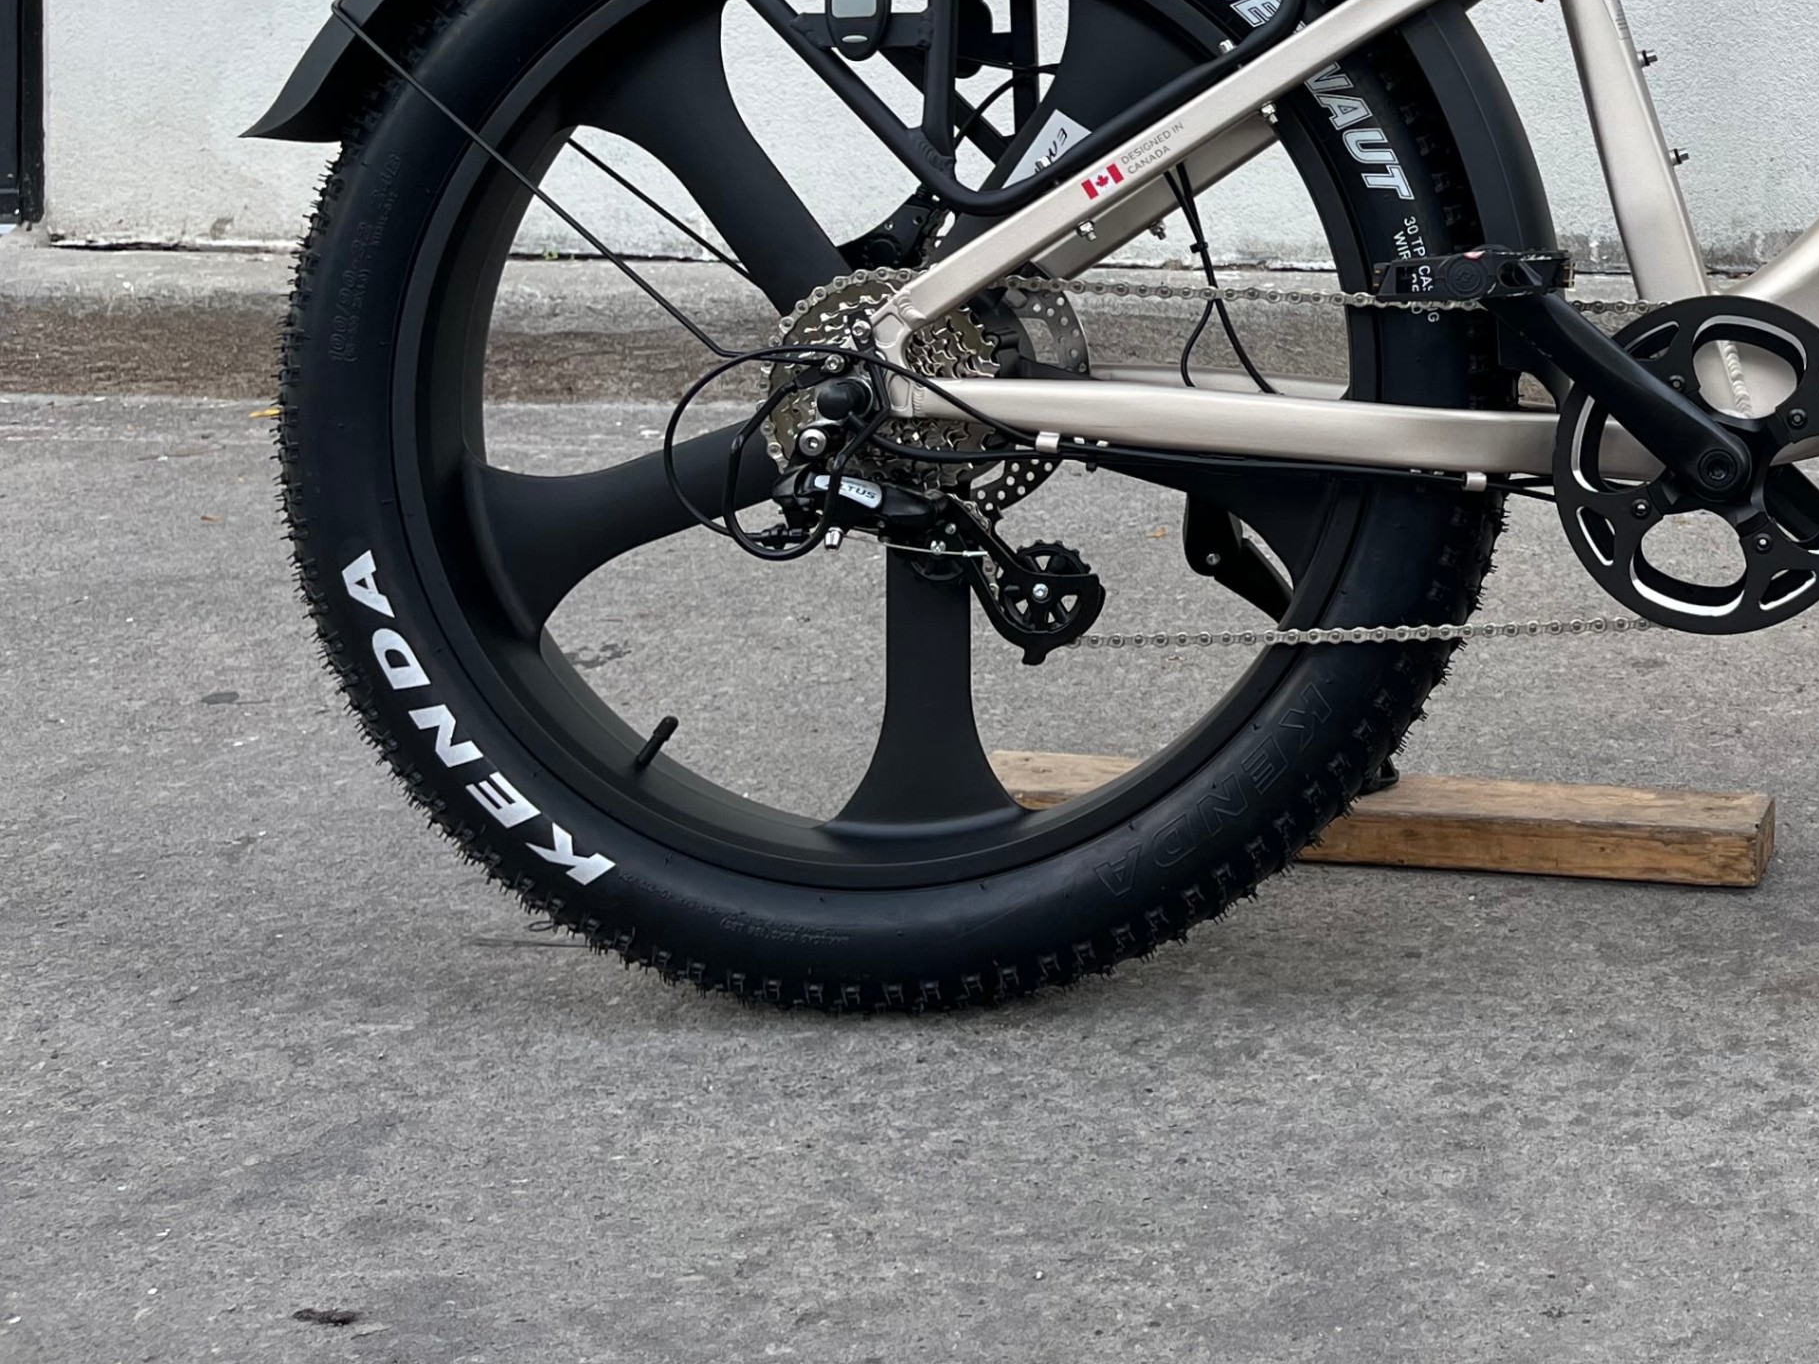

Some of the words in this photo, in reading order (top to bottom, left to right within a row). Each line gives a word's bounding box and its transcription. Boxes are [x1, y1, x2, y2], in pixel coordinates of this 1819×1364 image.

[1121, 130, 1171, 165] DESIGNED
[1171, 121, 1184, 134] IN
[1127, 145, 1171, 174] CANADA
[1403, 216, 1419, 235] 30
[1411, 236, 1428, 260] TP
[341, 549, 617, 886] KENDA
[1094, 684, 1333, 898] KENDA
